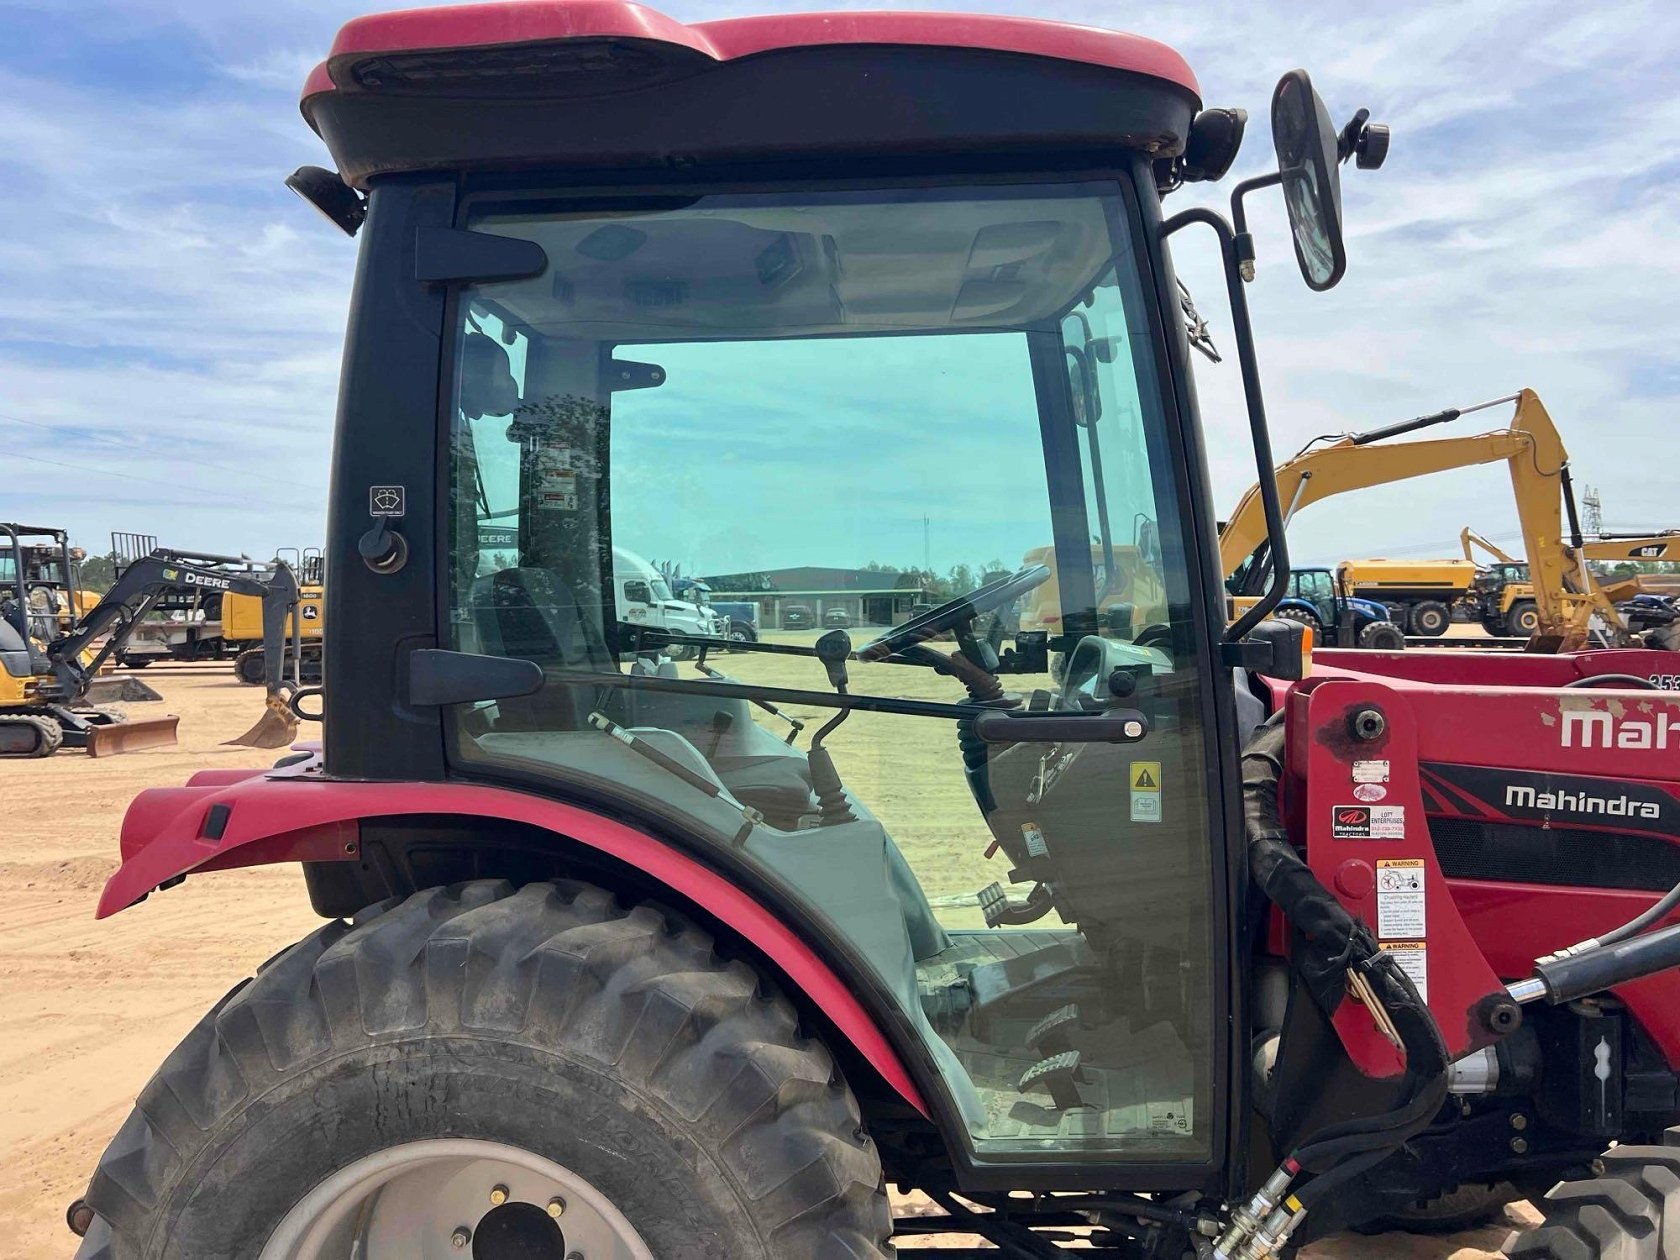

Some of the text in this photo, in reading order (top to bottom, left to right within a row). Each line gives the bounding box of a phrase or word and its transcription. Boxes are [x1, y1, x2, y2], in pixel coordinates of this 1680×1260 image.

[1641, 547, 1658, 557] CAT
[185, 572, 230, 589] DEERE
[1561, 711, 1680, 749] Mah
[1505, 786, 1660, 819] Mahindra
